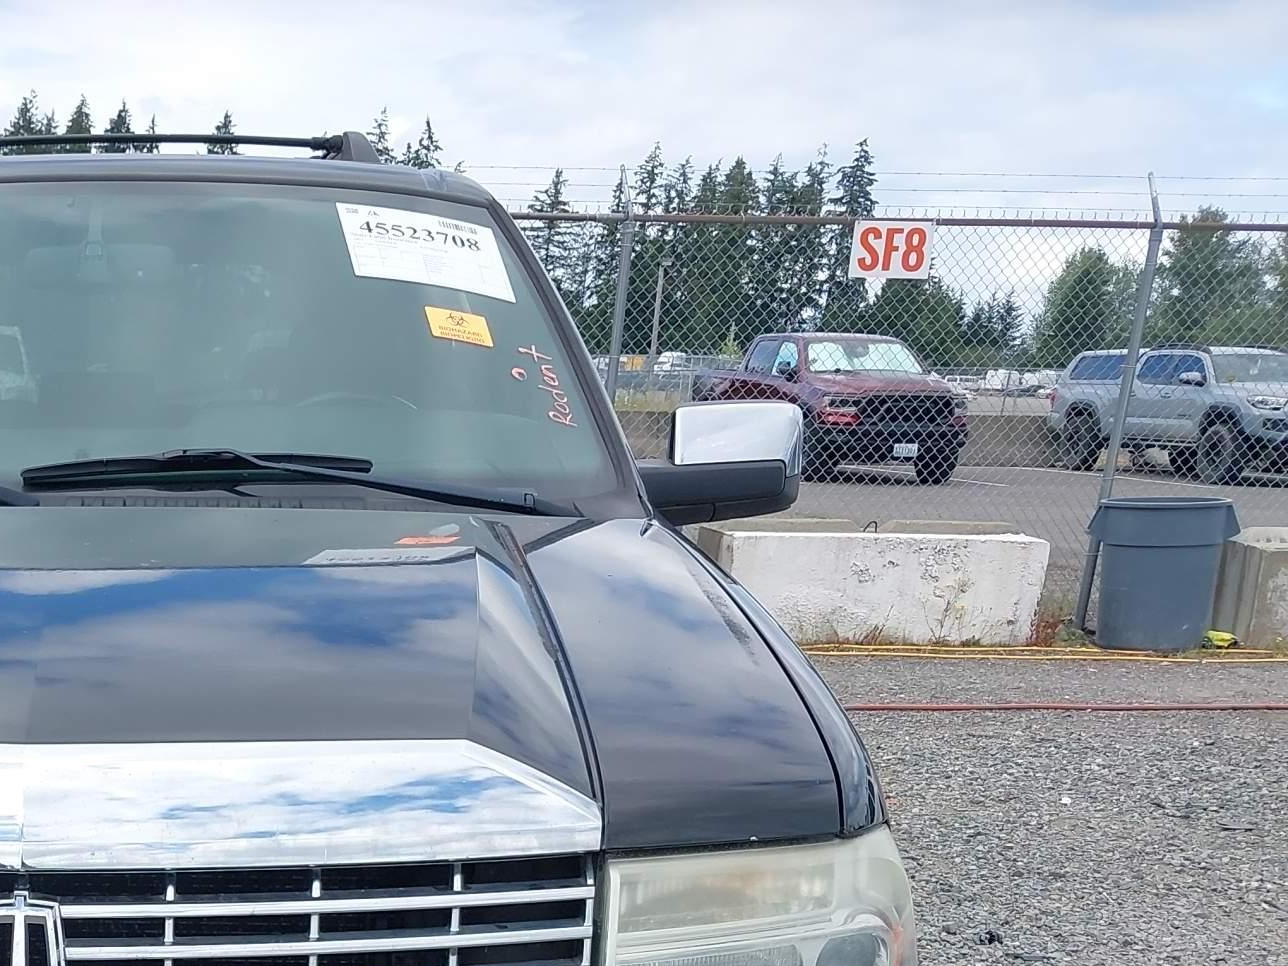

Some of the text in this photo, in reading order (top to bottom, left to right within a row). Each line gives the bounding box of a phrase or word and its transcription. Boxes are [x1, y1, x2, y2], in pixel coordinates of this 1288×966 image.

[359, 220, 481, 252] 45523708
[857, 226, 927, 273] SF8
[517, 344, 578, 427] Rodent
